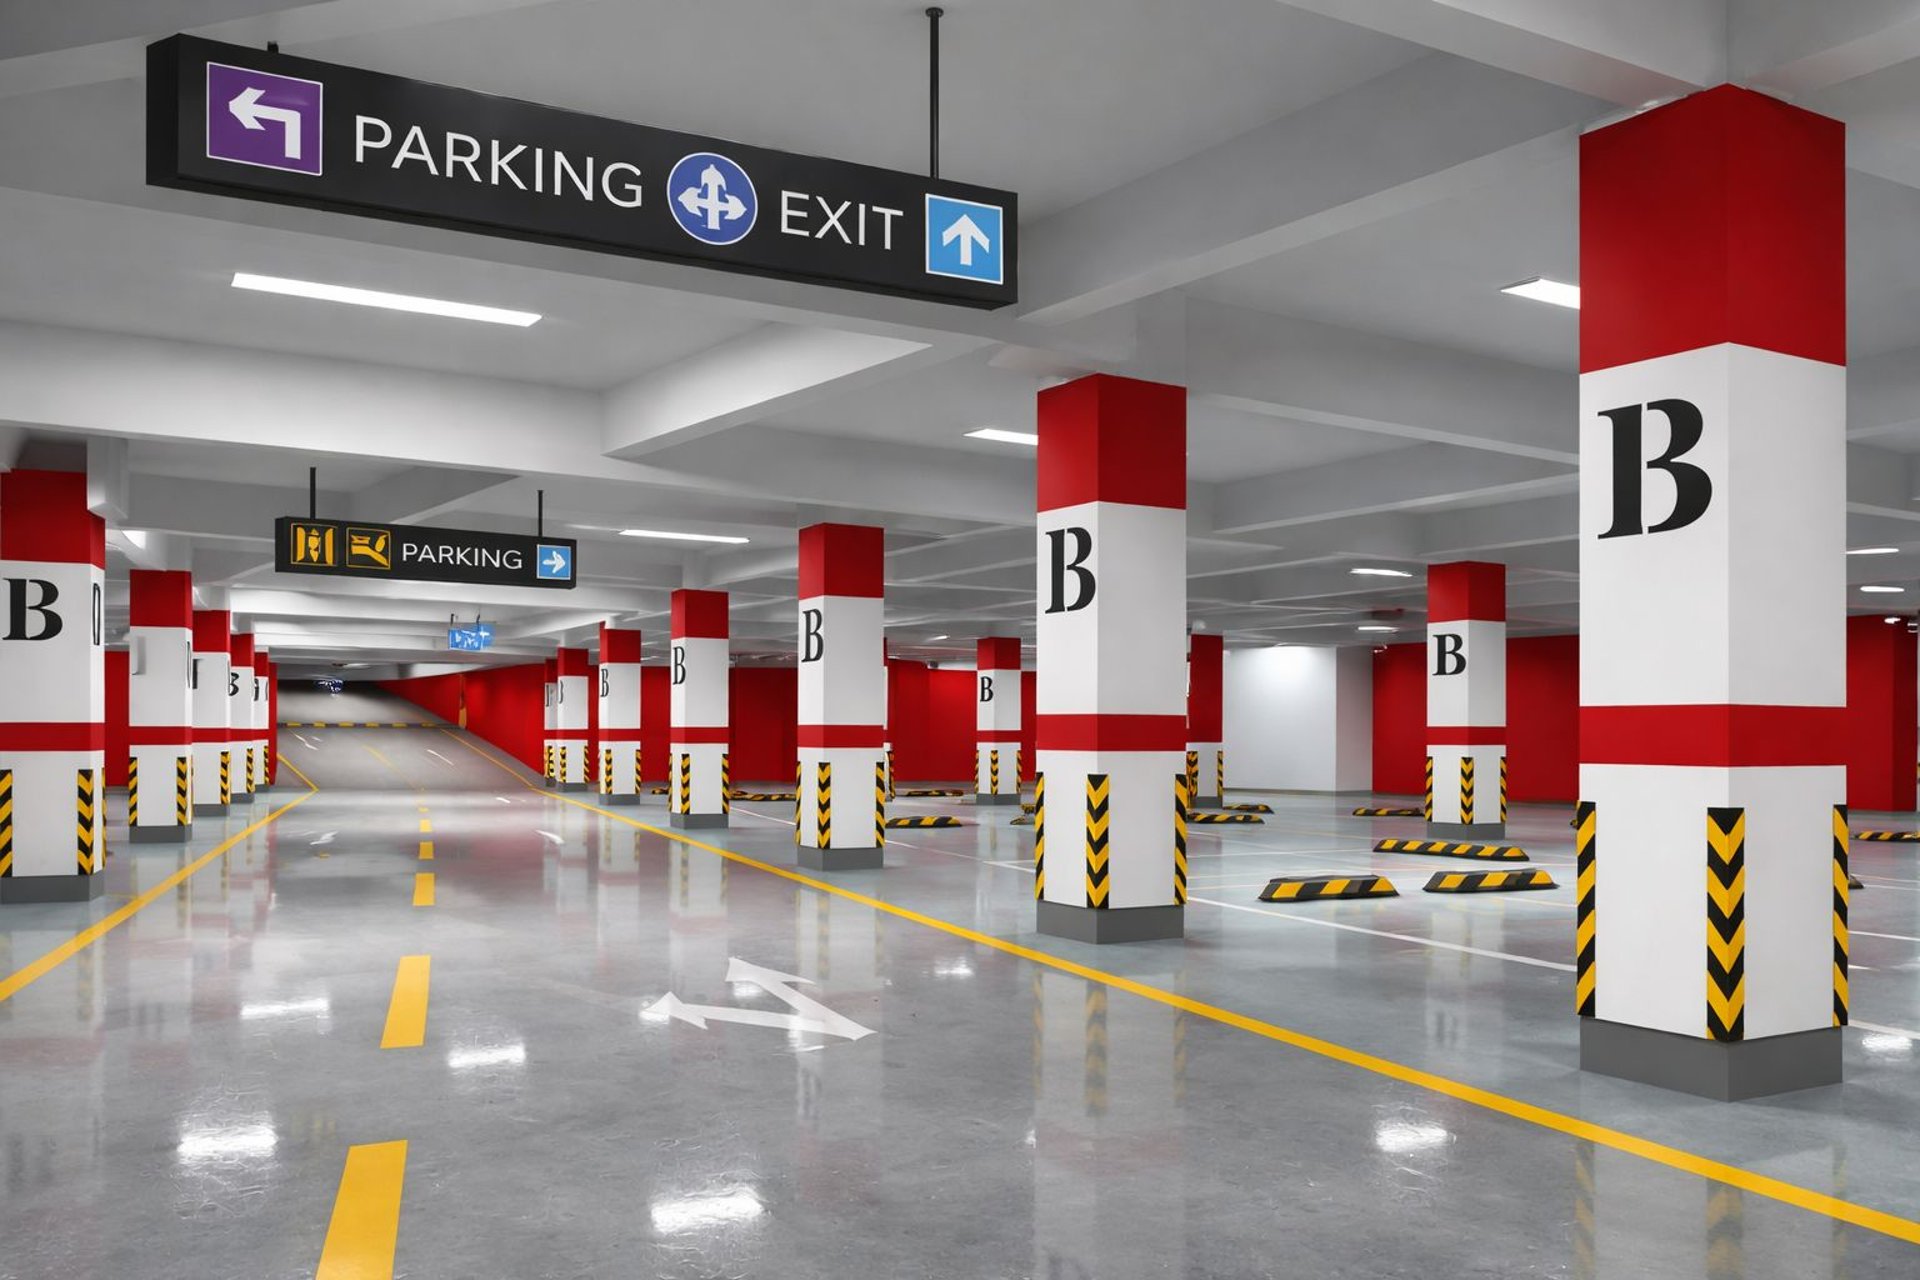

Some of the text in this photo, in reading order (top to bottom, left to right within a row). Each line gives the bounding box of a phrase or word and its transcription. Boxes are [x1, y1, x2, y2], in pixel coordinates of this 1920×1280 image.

[355, 114, 904, 250] PARKING EXIT
[1597, 398, 1713, 540] B
[402, 543, 523, 570] PARKING
[1045, 526, 1096, 614] B
[2, 577, 64, 641] B
[802, 608, 824, 663] B
[1432, 633, 1467, 676] B
[600, 668, 610, 698] B
[672, 646, 687, 685] B
[980, 675, 994, 702] B
